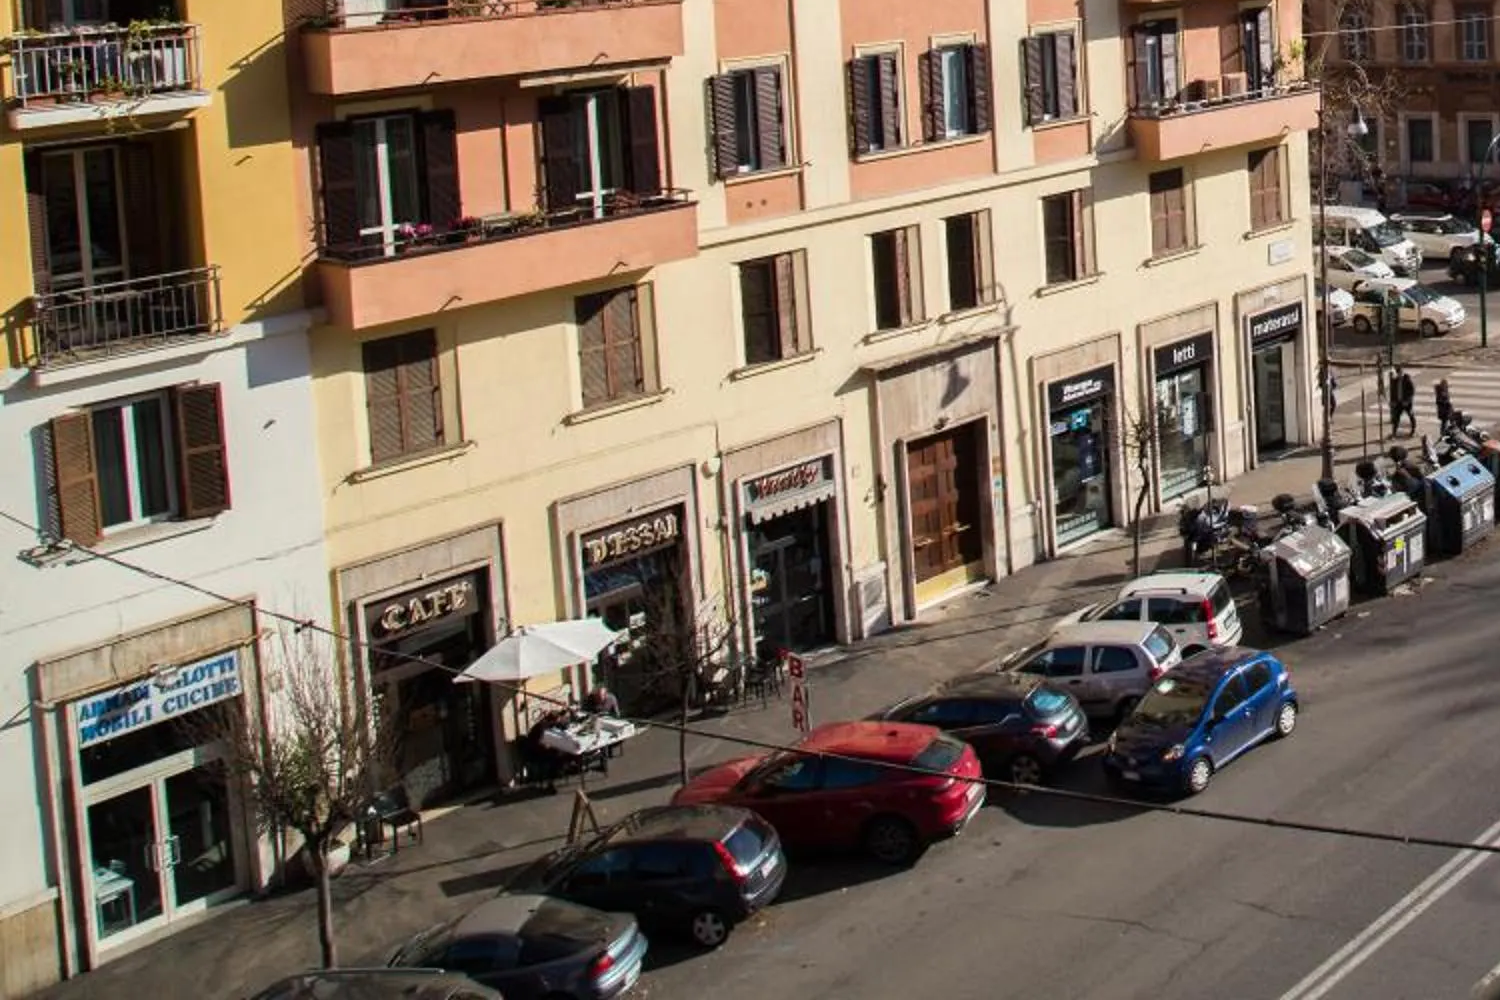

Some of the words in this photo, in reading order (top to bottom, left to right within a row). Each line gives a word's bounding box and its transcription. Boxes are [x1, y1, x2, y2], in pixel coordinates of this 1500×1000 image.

[1173, 343, 1196, 365] letti
[158, 655, 236, 693] LOTTI
[789, 657, 804, 732] BAR
[80, 704, 152, 744] MOBILI
[162, 676, 239, 715] CUCINE
